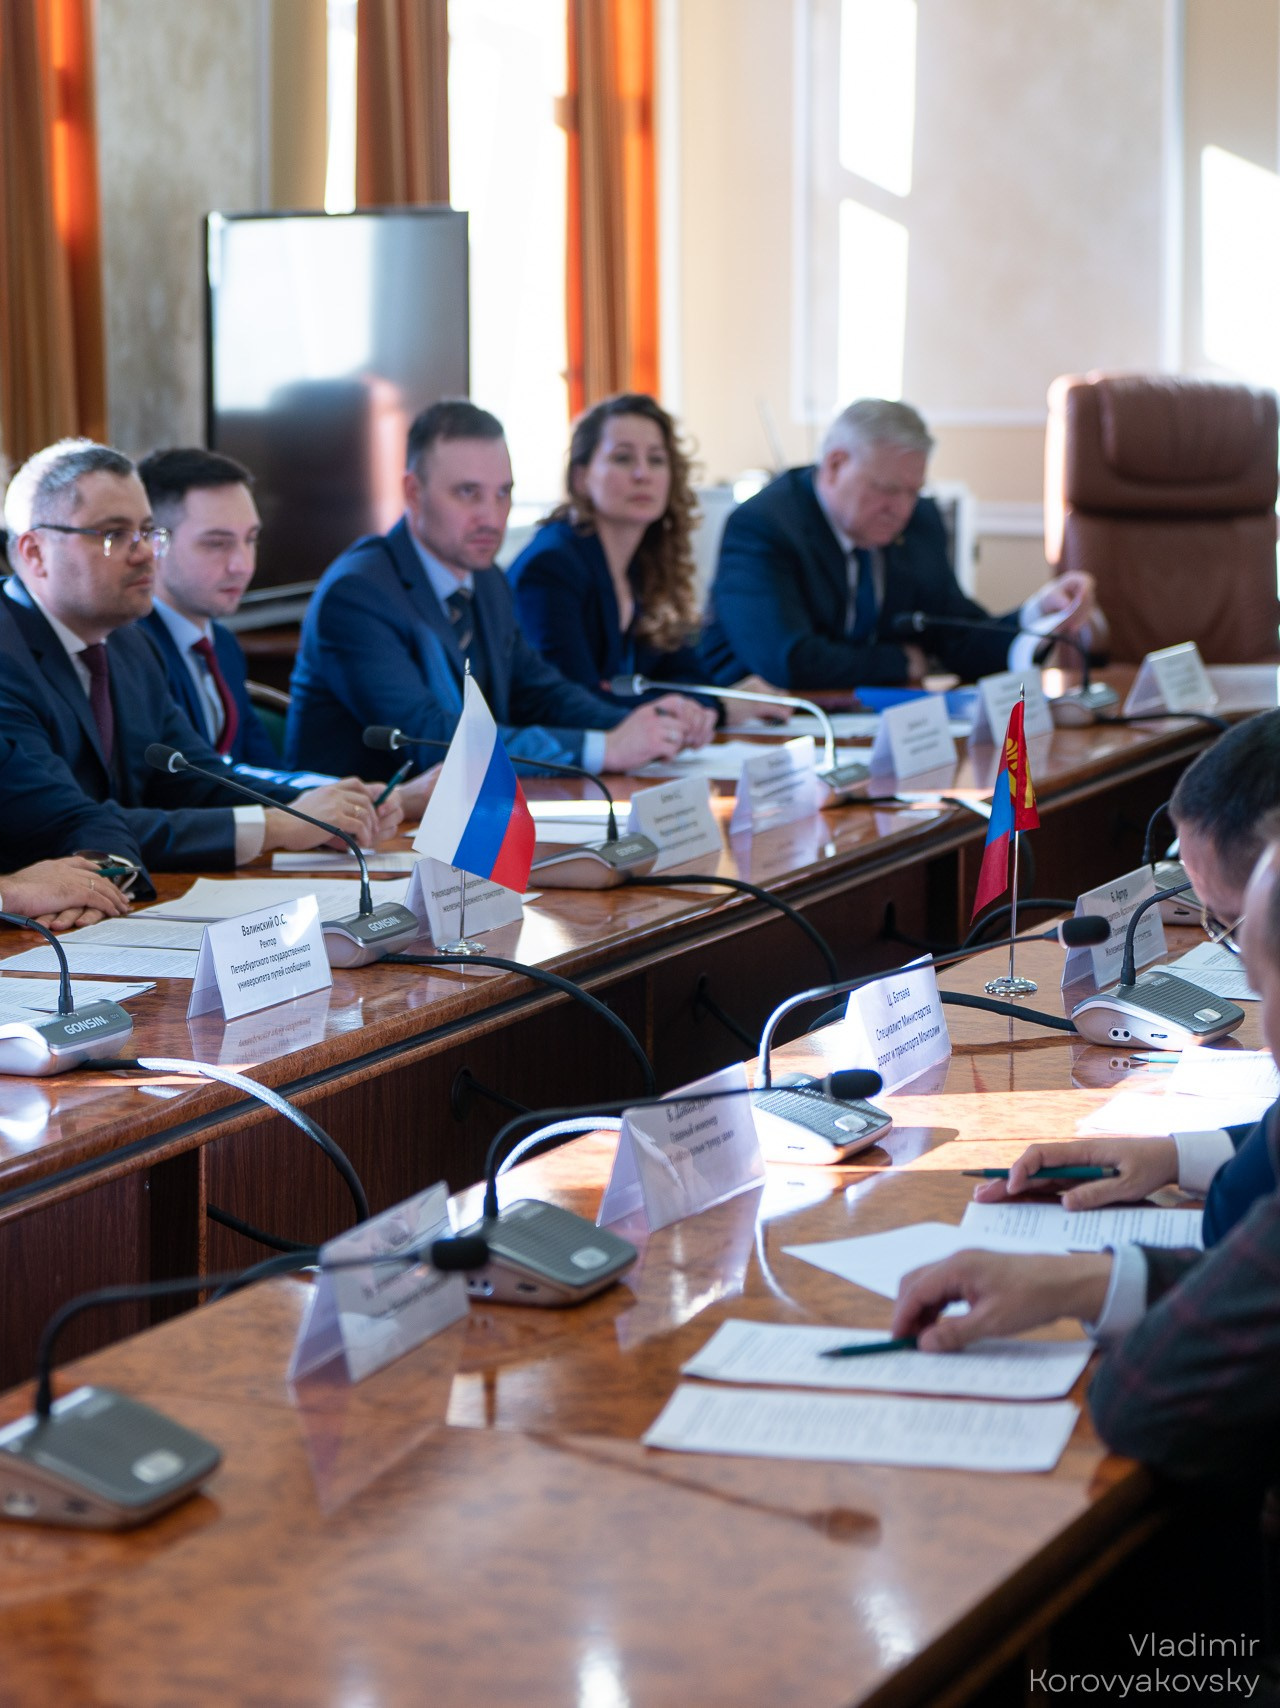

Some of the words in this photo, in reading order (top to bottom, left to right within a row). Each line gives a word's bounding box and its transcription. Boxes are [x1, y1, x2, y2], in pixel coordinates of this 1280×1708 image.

[241, 917, 274, 937] Валинский
[275, 913, 287, 926] О.С.
[259, 937, 277, 949] Ректор
[230, 957, 269, 975] Петербургского
[269, 943, 311, 962] государственного
[237, 973, 271, 992] университета
[271, 966, 285, 980] путей
[285, 960, 311, 975] сообщения
[63, 1015, 108, 1035] GONSIN
